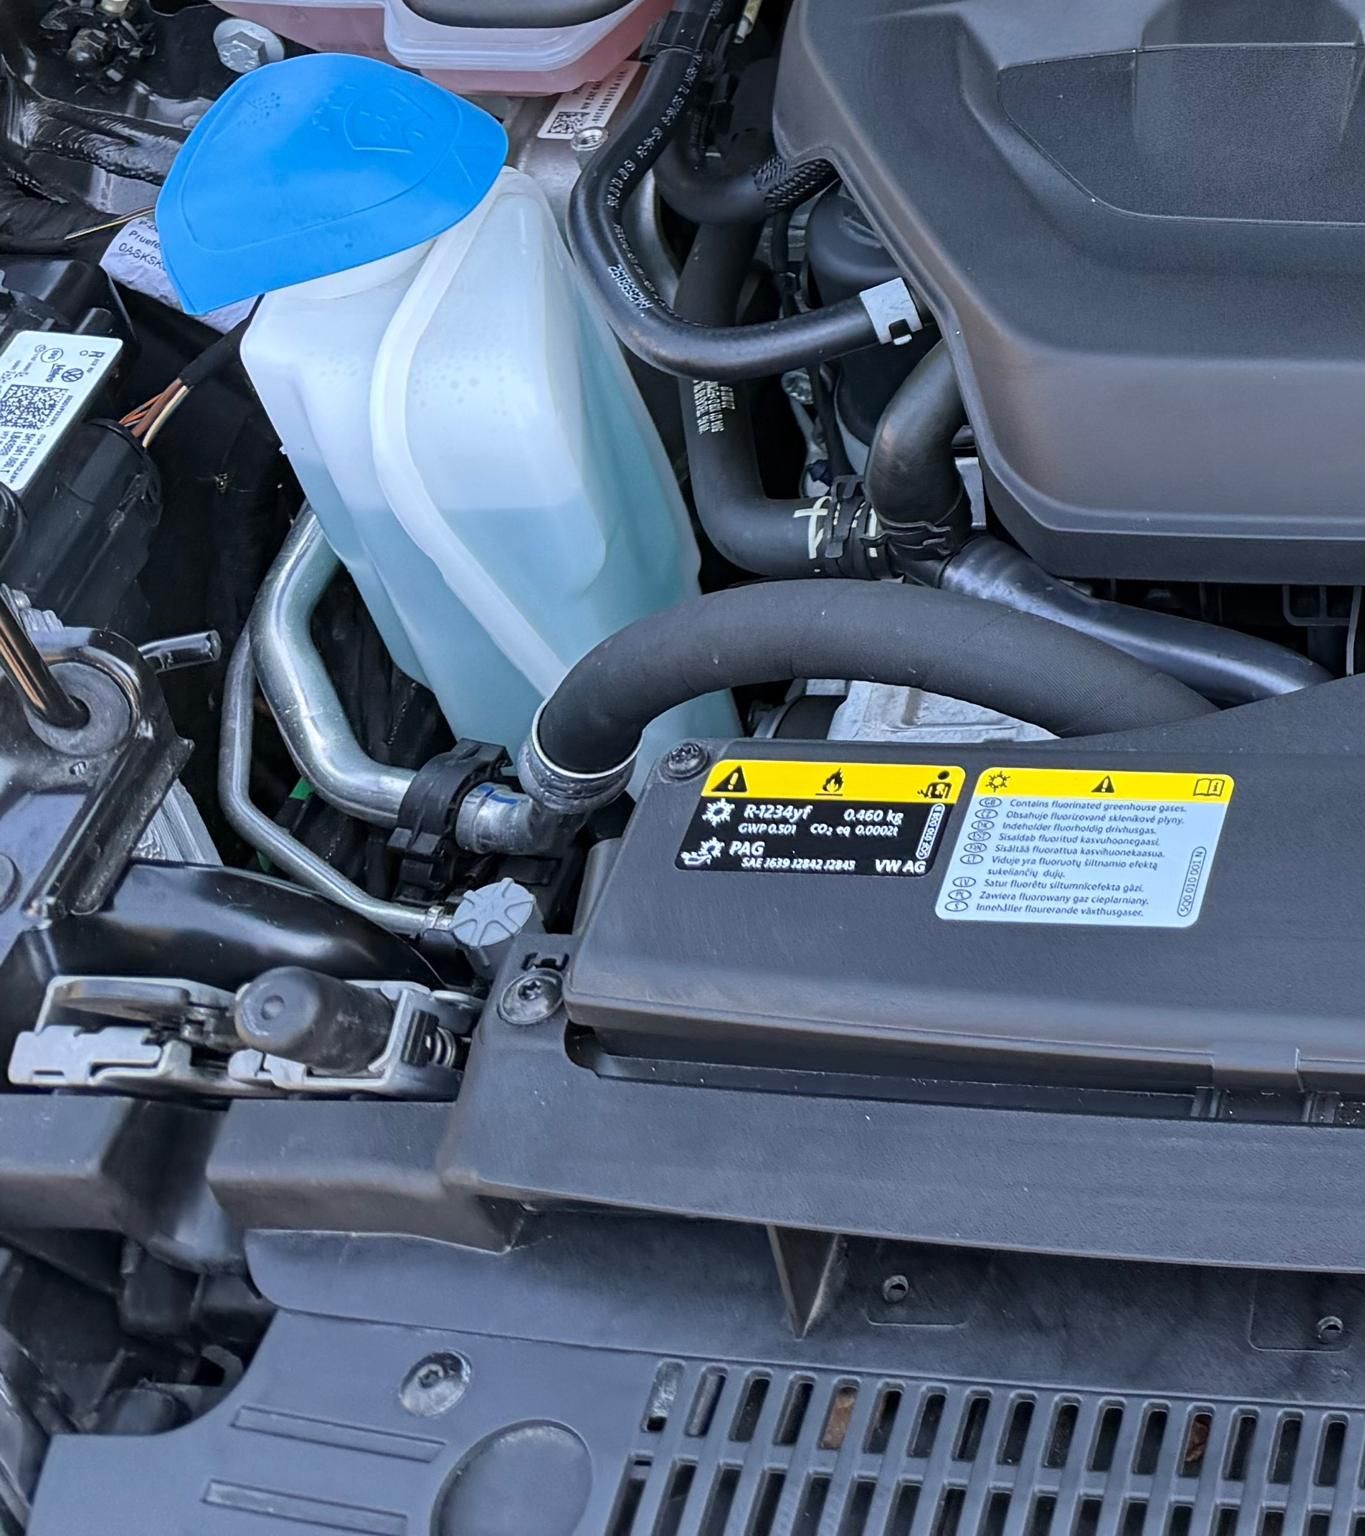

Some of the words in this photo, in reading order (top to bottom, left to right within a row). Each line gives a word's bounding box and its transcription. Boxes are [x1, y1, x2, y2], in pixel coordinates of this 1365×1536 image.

[1010, 799, 1049, 809] Contains
[1051, 799, 1101, 810] fluorinated
[1103, 802, 1157, 813] greenhouse
[1159, 804, 1187, 814] gases.
[743, 804, 814, 823] R-1234yf
[843, 809, 883, 822] 0.460
[885, 809, 904, 825] kg
[1006, 811, 1048, 821] Obsahuje
[1157, 816, 1185, 826] plyny.
[738, 824, 768, 834] GWP
[768, 824, 797, 835] 0.501
[836, 827, 851, 838] eq
[855, 825, 899, 837] 0.0002t
[1002, 821, 1051, 831] Indeholder
[1053, 822, 1104, 834] fluorholdig
[1106, 825, 1157, 836] drivhusgas.
[998, 832, 1036, 842] Sisaldab
[1038, 834, 1078, 844] fluoritud
[1080, 835, 1161, 847] kasvuhoonegaasi.
[729, 841, 765, 856] PAG
[1032, 845, 1078, 856] fluorattua
[1080, 847, 1165, 858] kasvihuonekaasua.
[741, 858, 761, 868] SAE
[875, 859, 904, 872] VW
[904, 860, 927, 873] AG
[992, 856, 1023, 866] Viduje
[1024, 859, 1037, 867] yra
[984, 879, 1009, 887] Satur
[979, 891, 1017, 901] Zawiera
[1019, 892, 1071, 903] fluorowany
[1073, 896, 1089, 905] gaz
[1091, 895, 1149, 906] cieplarniany.
